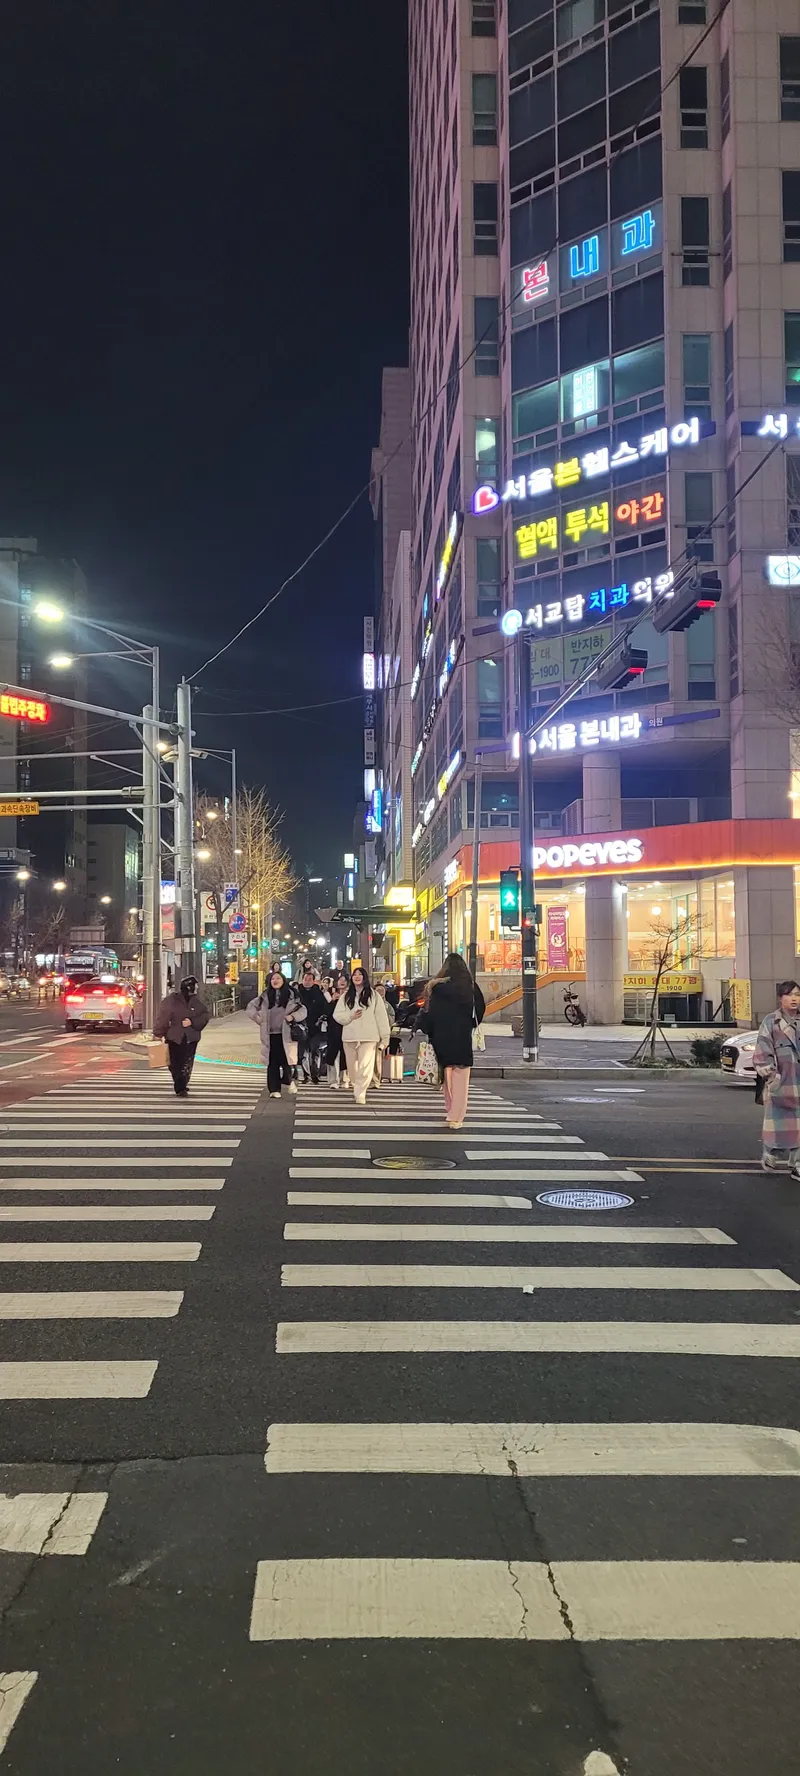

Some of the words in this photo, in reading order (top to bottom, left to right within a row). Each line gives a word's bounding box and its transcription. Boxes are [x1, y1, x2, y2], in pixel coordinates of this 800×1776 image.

[757, 413, 800, 439] 서
[515, 516, 559, 559] 혈액
[565, 501, 609, 543] 투석
[616, 491, 664, 526] 야간
[571, 634, 604, 653] 반지하
[648, 717, 663, 727] 의원
[1, 804, 37, 813] 과속단속장비
